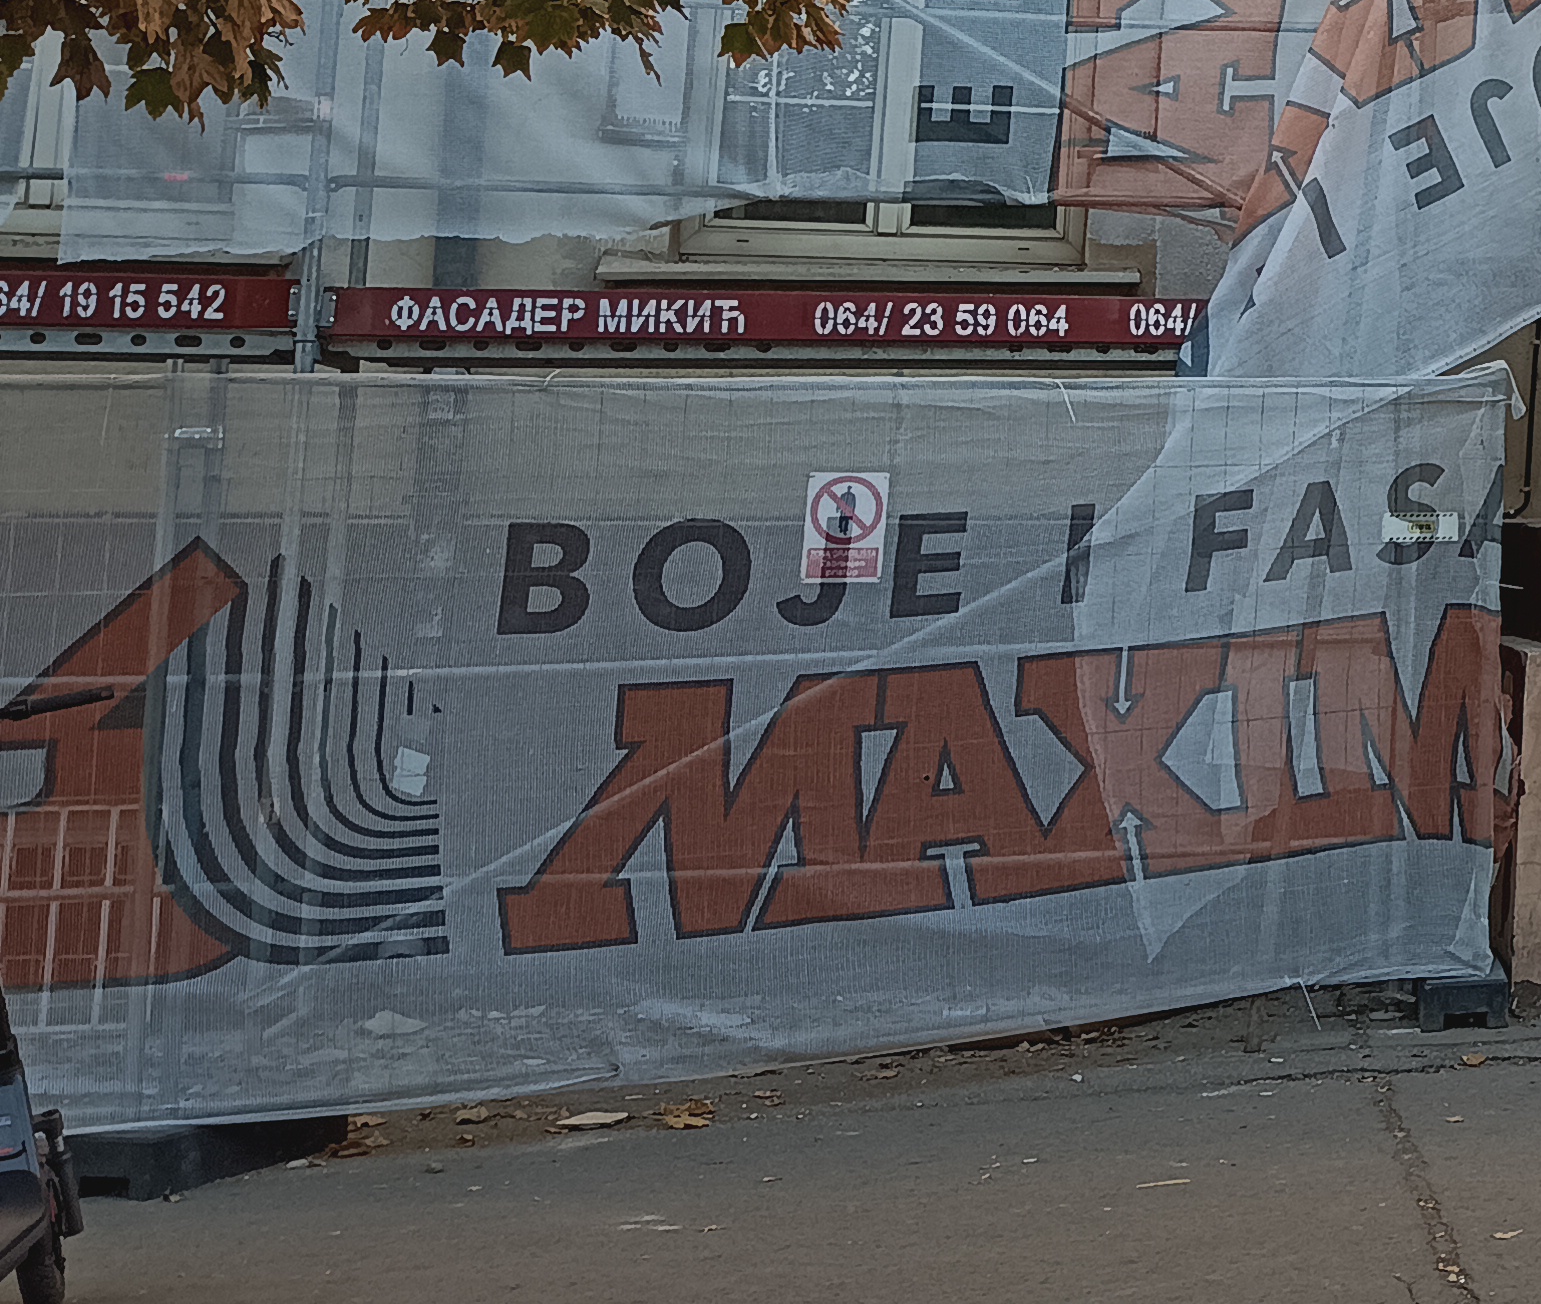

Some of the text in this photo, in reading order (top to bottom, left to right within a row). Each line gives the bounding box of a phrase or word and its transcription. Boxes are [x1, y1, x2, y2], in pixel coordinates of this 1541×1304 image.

[59, 282, 98, 318] 19
[109, 282, 147, 319] 15
[158, 283, 226, 320] 542
[391, 295, 586, 336] ФАСАДЕР
[597, 298, 745, 334] МИКИЋ
[814, 301, 894, 336] 064/
[902, 302, 944, 336] 23
[955, 303, 997, 337] 59
[1007, 304, 1069, 337] 064
[496, 510, 969, 637] BOJE
[1060, 503, 1096, 605] I
